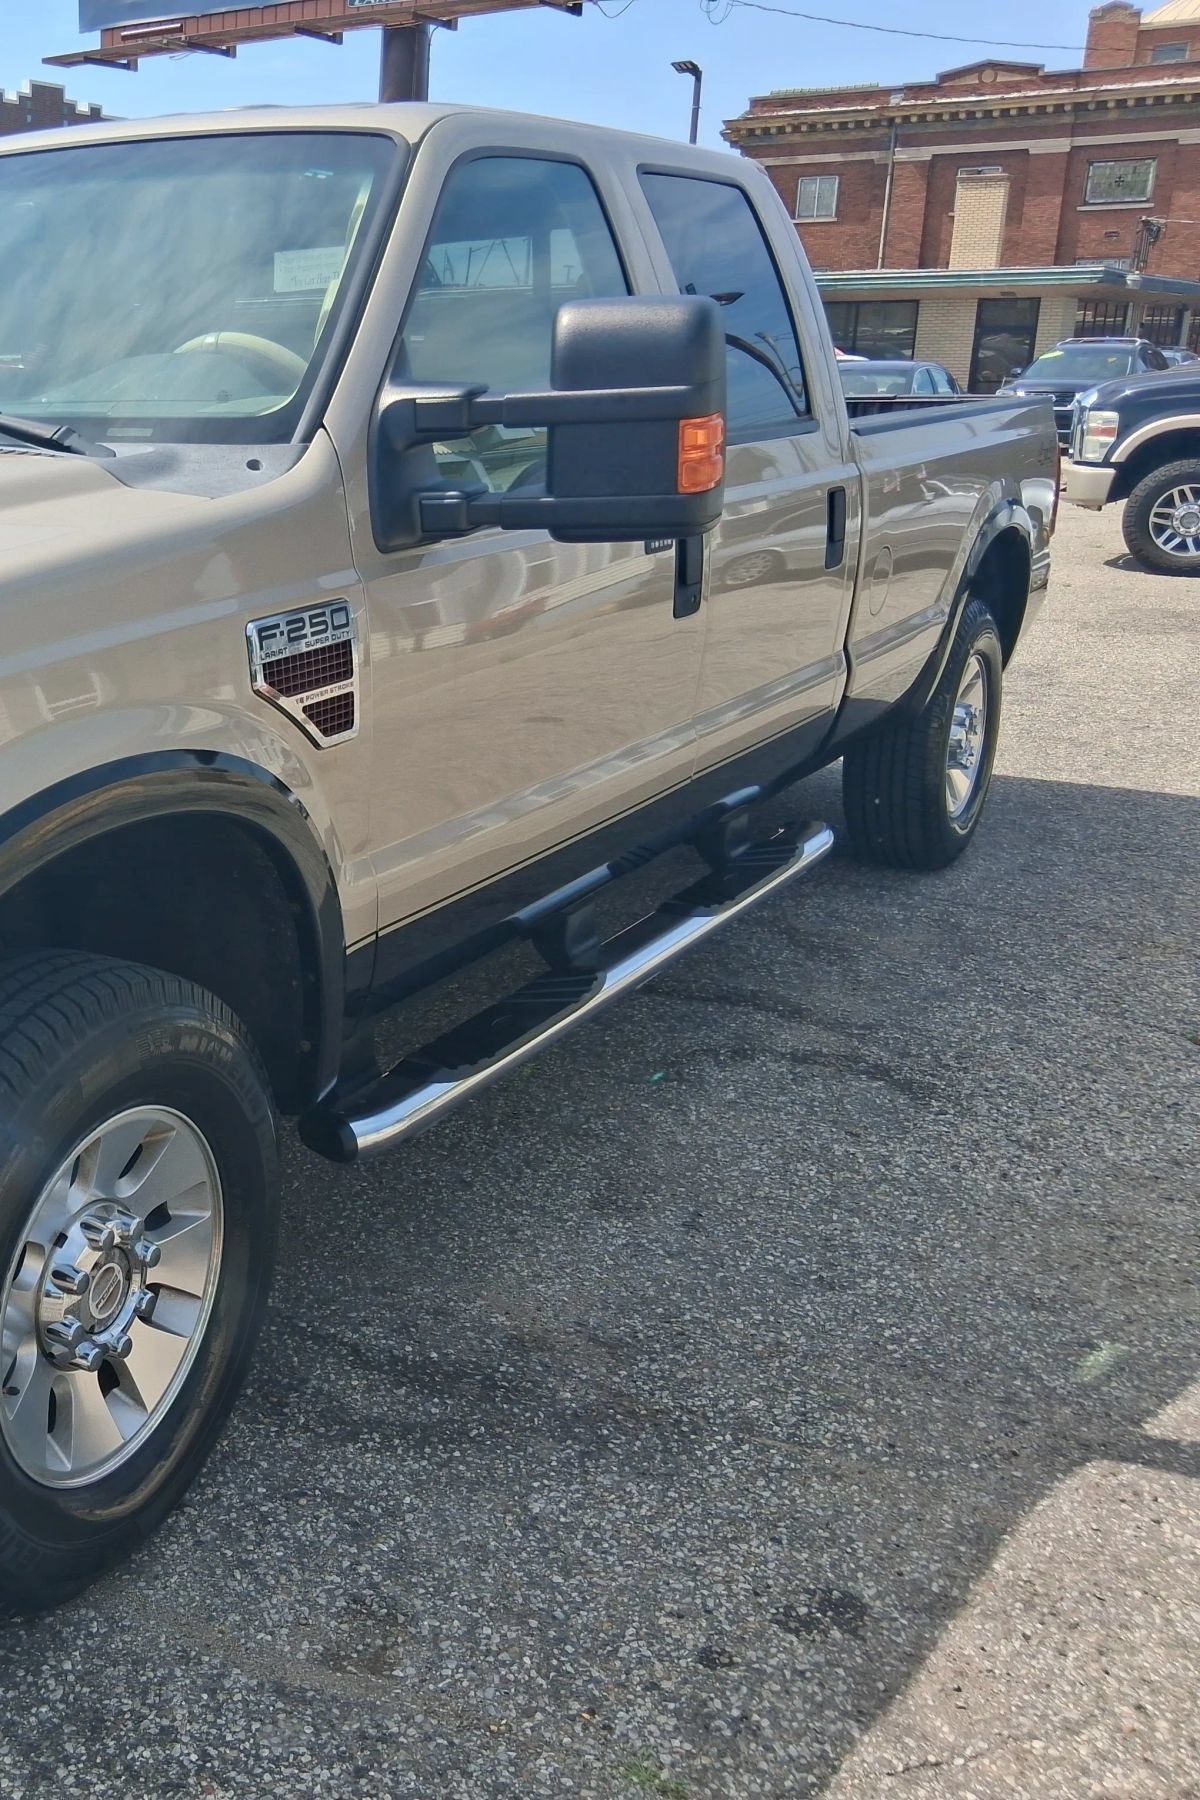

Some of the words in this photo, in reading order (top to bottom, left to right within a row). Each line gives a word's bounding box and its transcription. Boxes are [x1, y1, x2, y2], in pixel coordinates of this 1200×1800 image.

[260, 646, 288, 661] LARIAT
[304, 635, 330, 649] SUPER
[331, 629, 351, 642] DUTY
